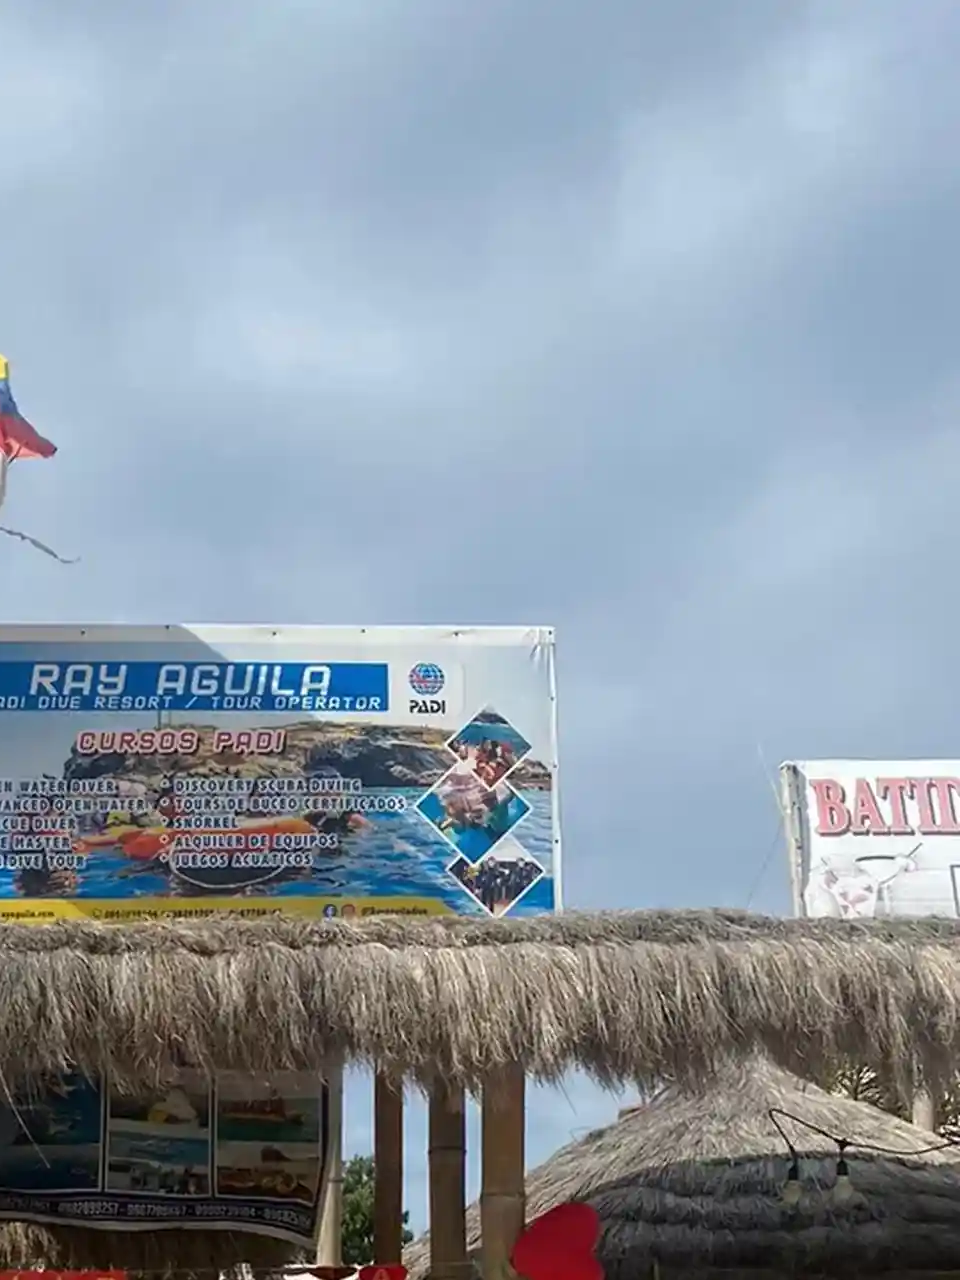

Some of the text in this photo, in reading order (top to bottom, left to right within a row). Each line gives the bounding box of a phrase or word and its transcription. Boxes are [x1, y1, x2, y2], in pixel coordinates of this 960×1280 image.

[29, 664, 332, 697] RAY AGUILA
[38, 696, 81, 709] DIVE
[94, 696, 174, 709] RESORT
[212, 696, 263, 710] TOUR
[276, 696, 381, 710] OPERATOR
[409, 700, 446, 714] PADI
[78, 729, 287, 754] CURSOS PADI
[20, 780, 67, 793] WATER
[72, 780, 115, 793] DIVER
[175, 779, 362, 793] DISCOVERY SCUBA DIVING
[55, 799, 93, 812] OPEN
[99, 799, 147, 812] WATER
[175, 797, 406, 811] TOURS DE BUCEO CERTIFICADOS
[33, 818, 78, 831] DIVER
[175, 816, 238, 829] SNORKEL
[13, 836, 72, 849] MASTER
[174, 834, 339, 848] ALQUILER DE EQUIPOS
[9, 855, 42, 868] DIVE
[47, 855, 85, 868] TOUR
[175, 853, 228, 866] JUEGOS
